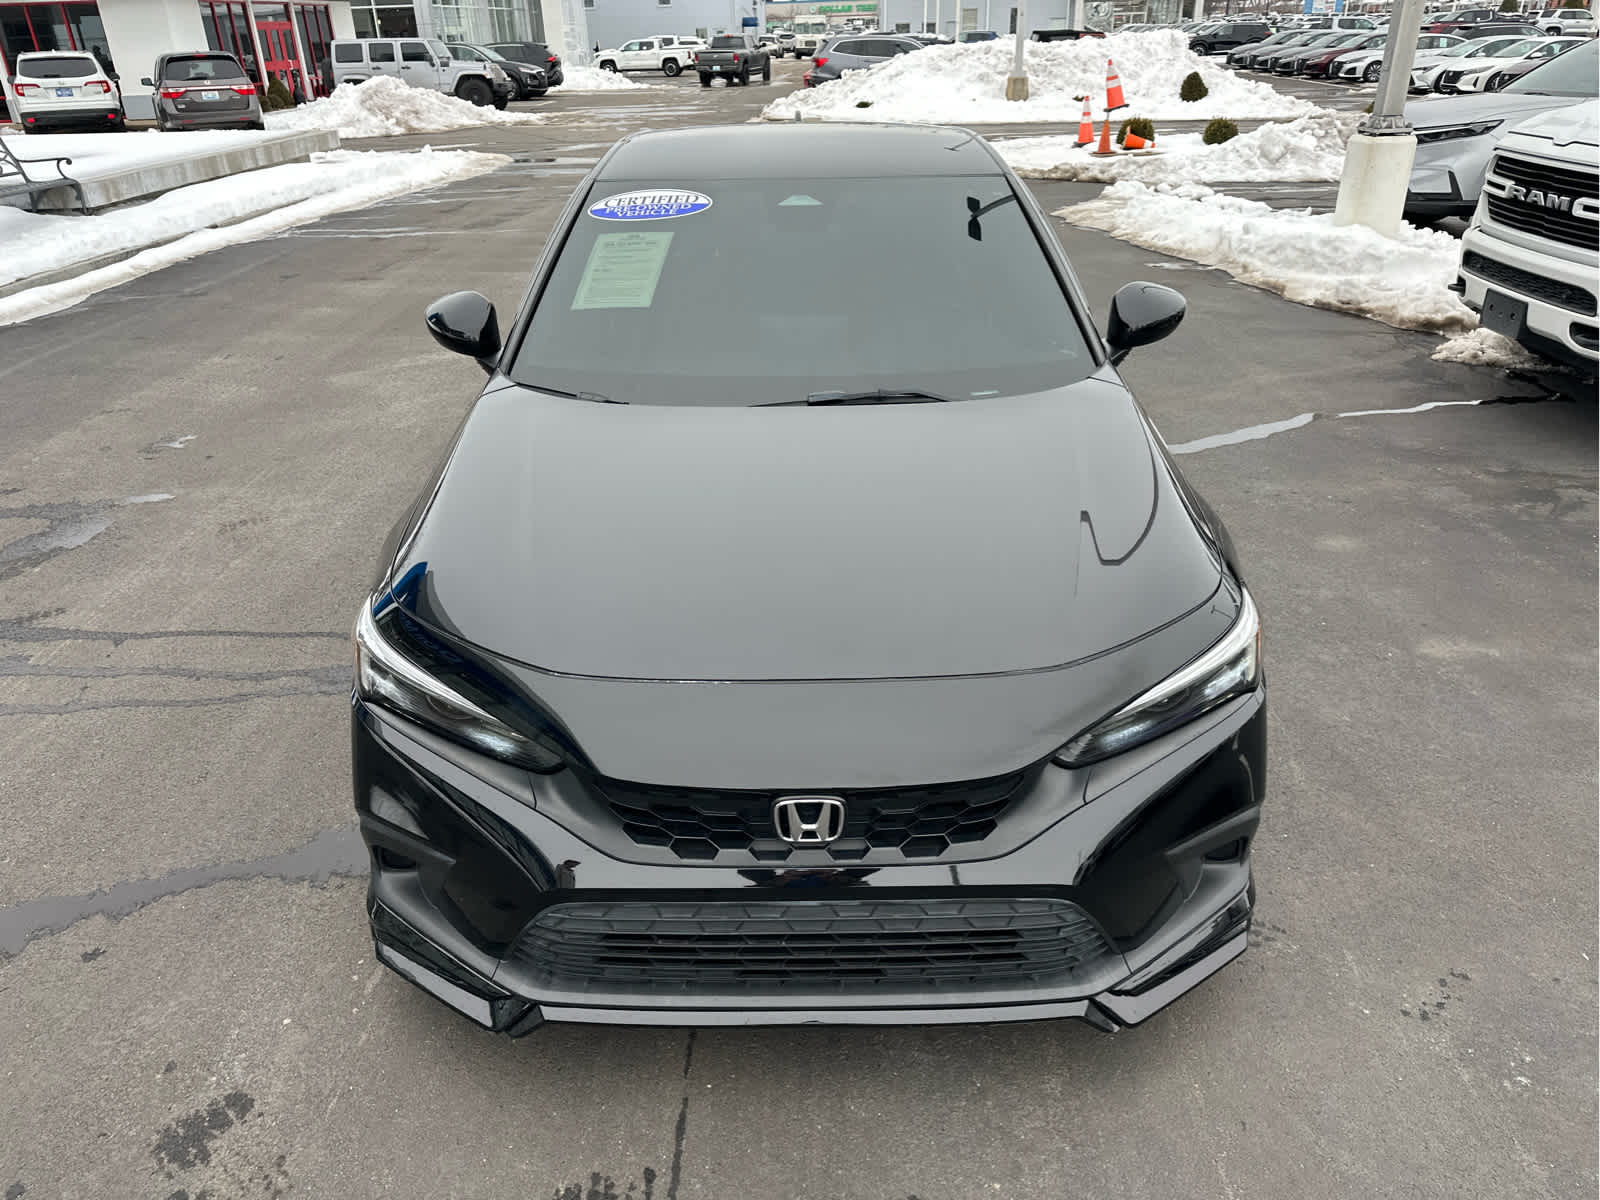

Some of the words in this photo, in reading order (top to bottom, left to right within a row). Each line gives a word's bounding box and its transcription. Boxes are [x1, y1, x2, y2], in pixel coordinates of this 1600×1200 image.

[604, 194, 699, 208] CERTIFIED
[1509, 184, 1571, 212] RAM
[605, 203, 693, 214] PRE-OWNED
[616, 208, 678, 217] VEHICLE
